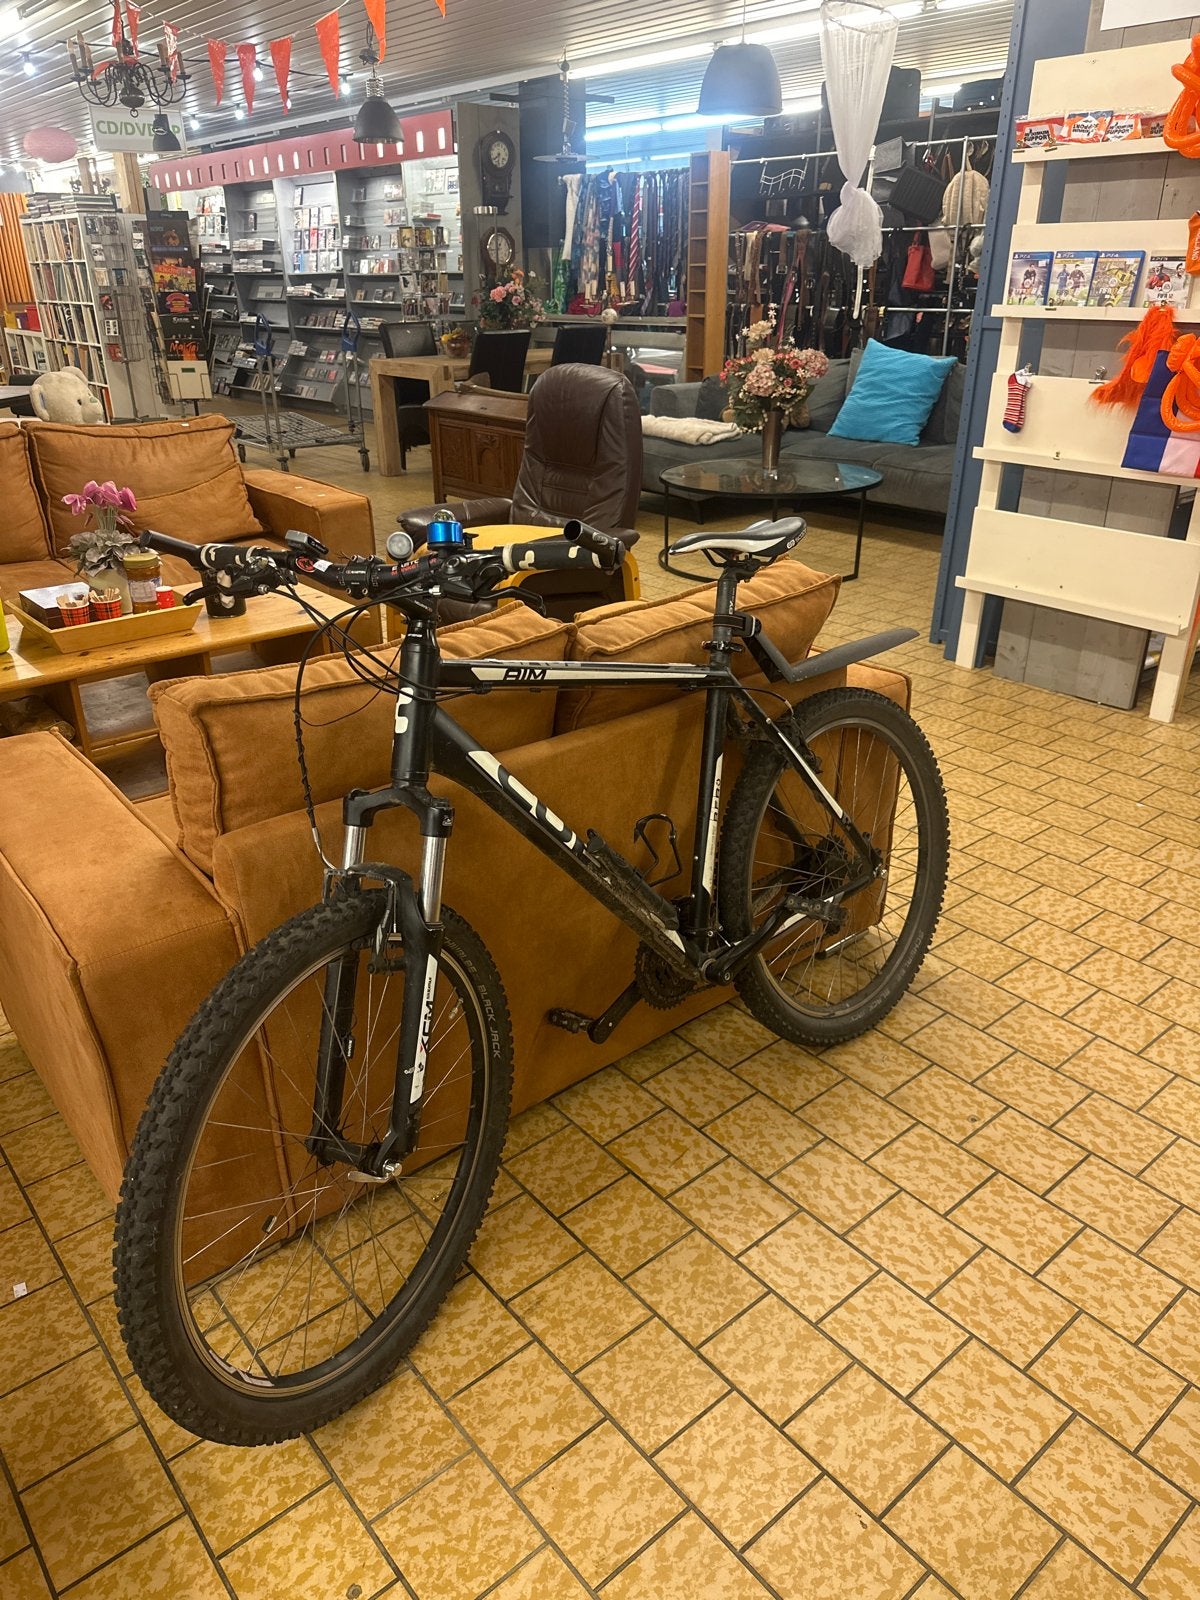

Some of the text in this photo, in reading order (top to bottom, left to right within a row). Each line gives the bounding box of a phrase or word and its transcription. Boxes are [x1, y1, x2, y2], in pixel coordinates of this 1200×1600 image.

[502, 667, 547, 681] AIM
[478, 984, 501, 1059] BLACK JACK
